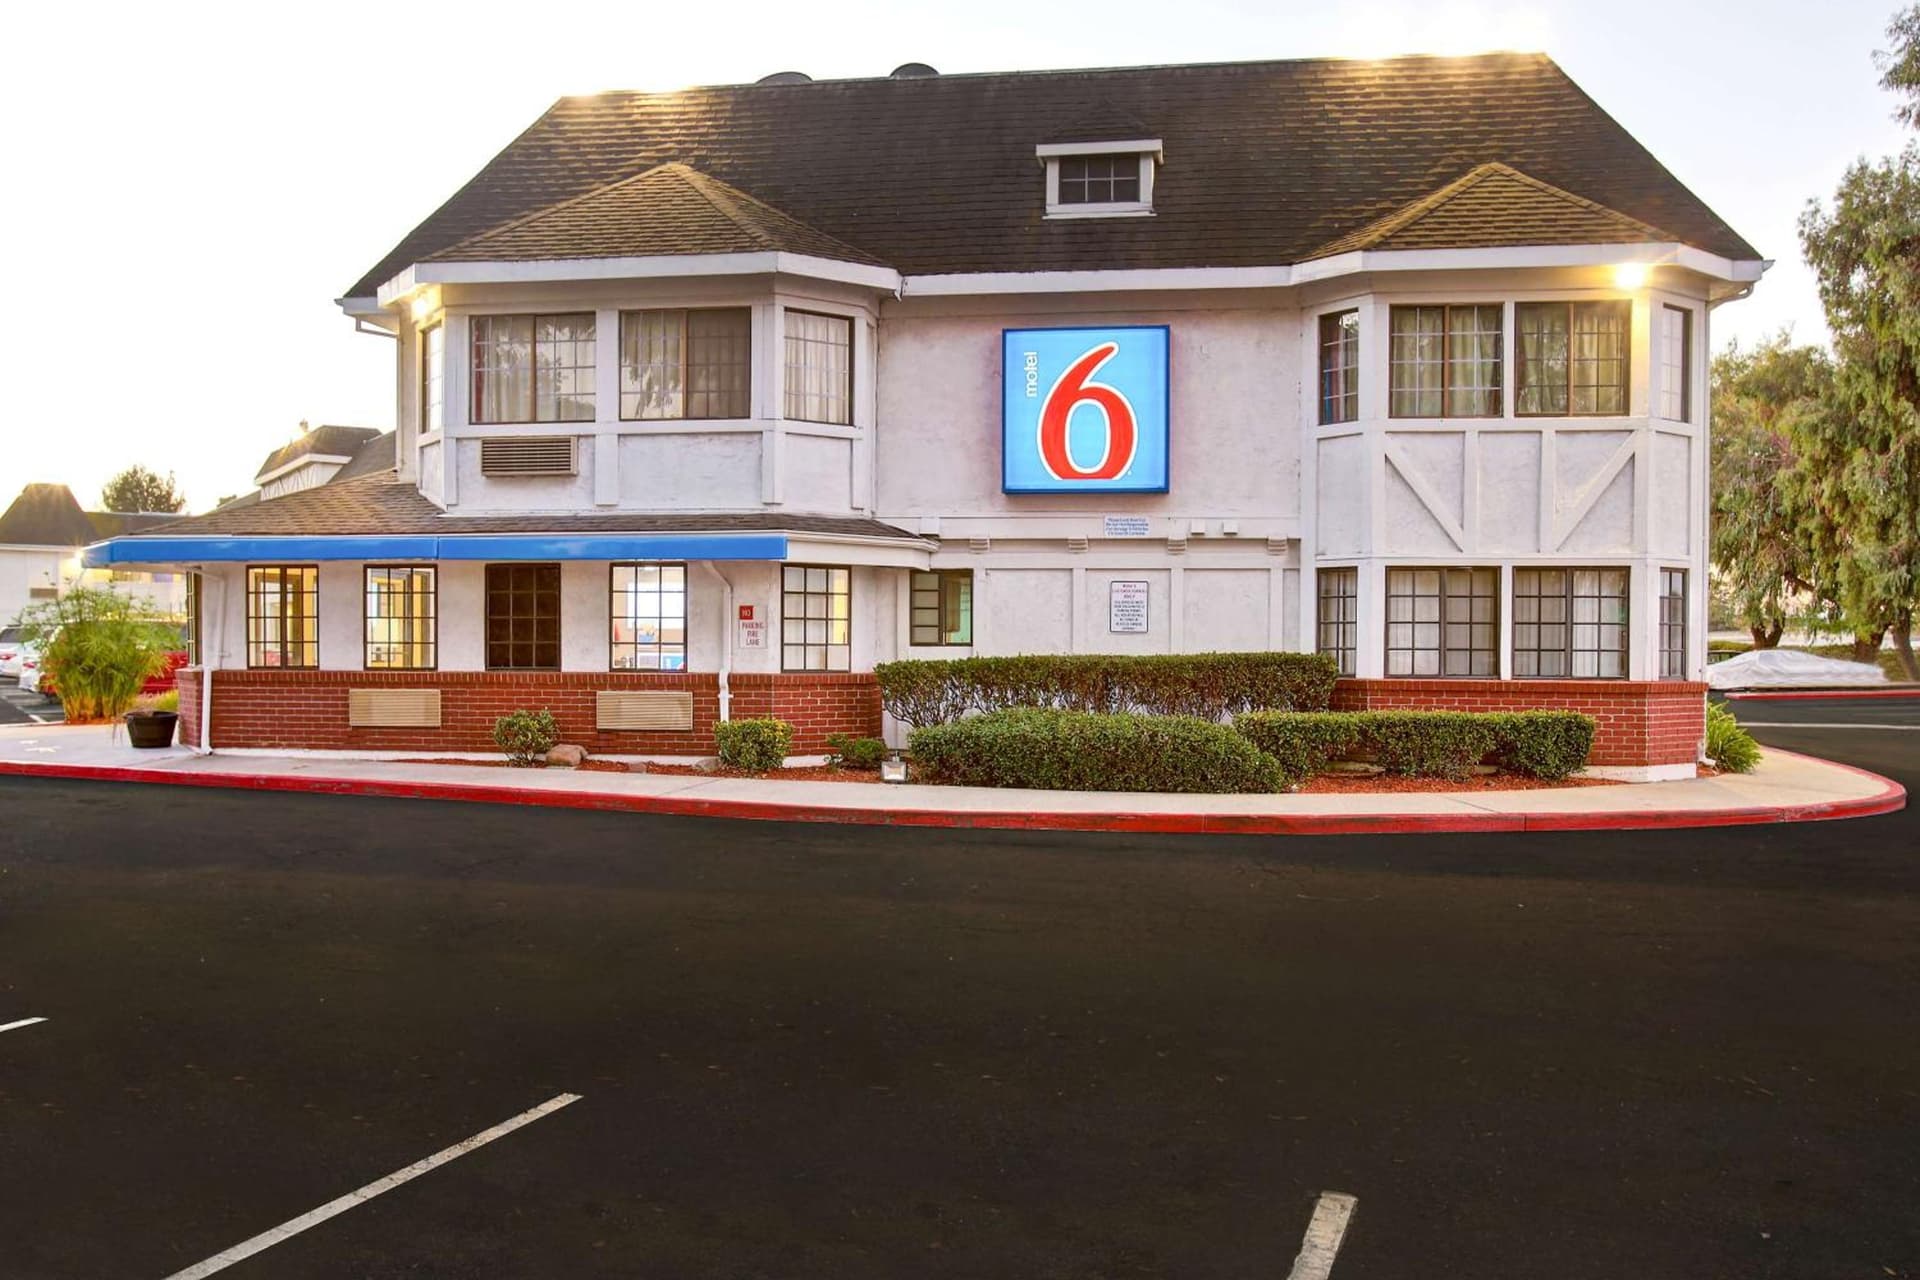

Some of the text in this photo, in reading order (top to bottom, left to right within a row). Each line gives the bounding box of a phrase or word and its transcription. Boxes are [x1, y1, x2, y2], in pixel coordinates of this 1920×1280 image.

[1023, 351, 1038, 398] motel
[1037, 341, 1139, 481] 6
[741, 607, 751, 617] NO
